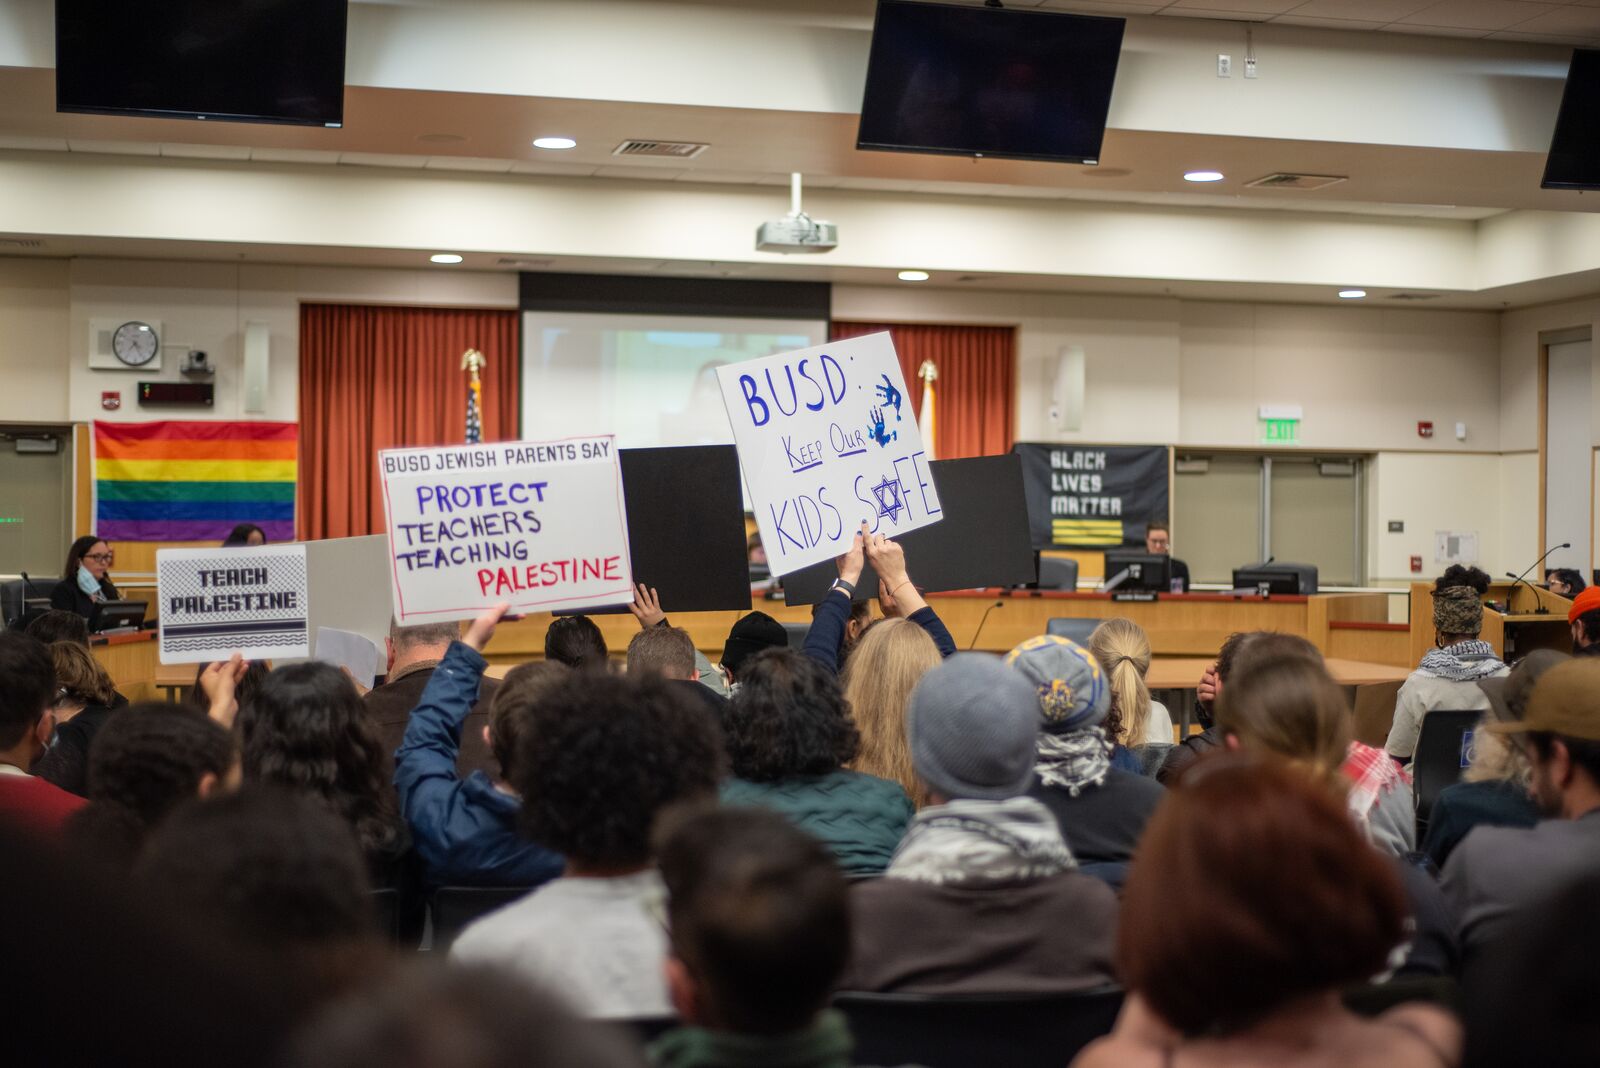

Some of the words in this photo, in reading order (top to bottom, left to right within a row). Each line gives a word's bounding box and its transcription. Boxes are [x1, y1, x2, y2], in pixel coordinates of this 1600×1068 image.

[1266, 419, 1297, 441] EXIT
[385, 456, 431, 473] BUSD
[435, 451, 497, 470] JEWISH
[505, 445, 577, 465] PARENTS
[581, 441, 609, 459] SAY
[1050, 451, 1106, 470] BLACK
[1051, 473, 1102, 493] LIVES
[416, 482, 548, 515] PROTECT
[1051, 496, 1122, 515] MATTER
[398, 511, 541, 545] TEACHERS
[770, 486, 842, 555] KIDS
[396, 540, 528, 571] TEACHING
[198, 567, 268, 588] TEACH
[477, 556, 623, 596] PALESTINE
[170, 591, 297, 615] PALESTINE
